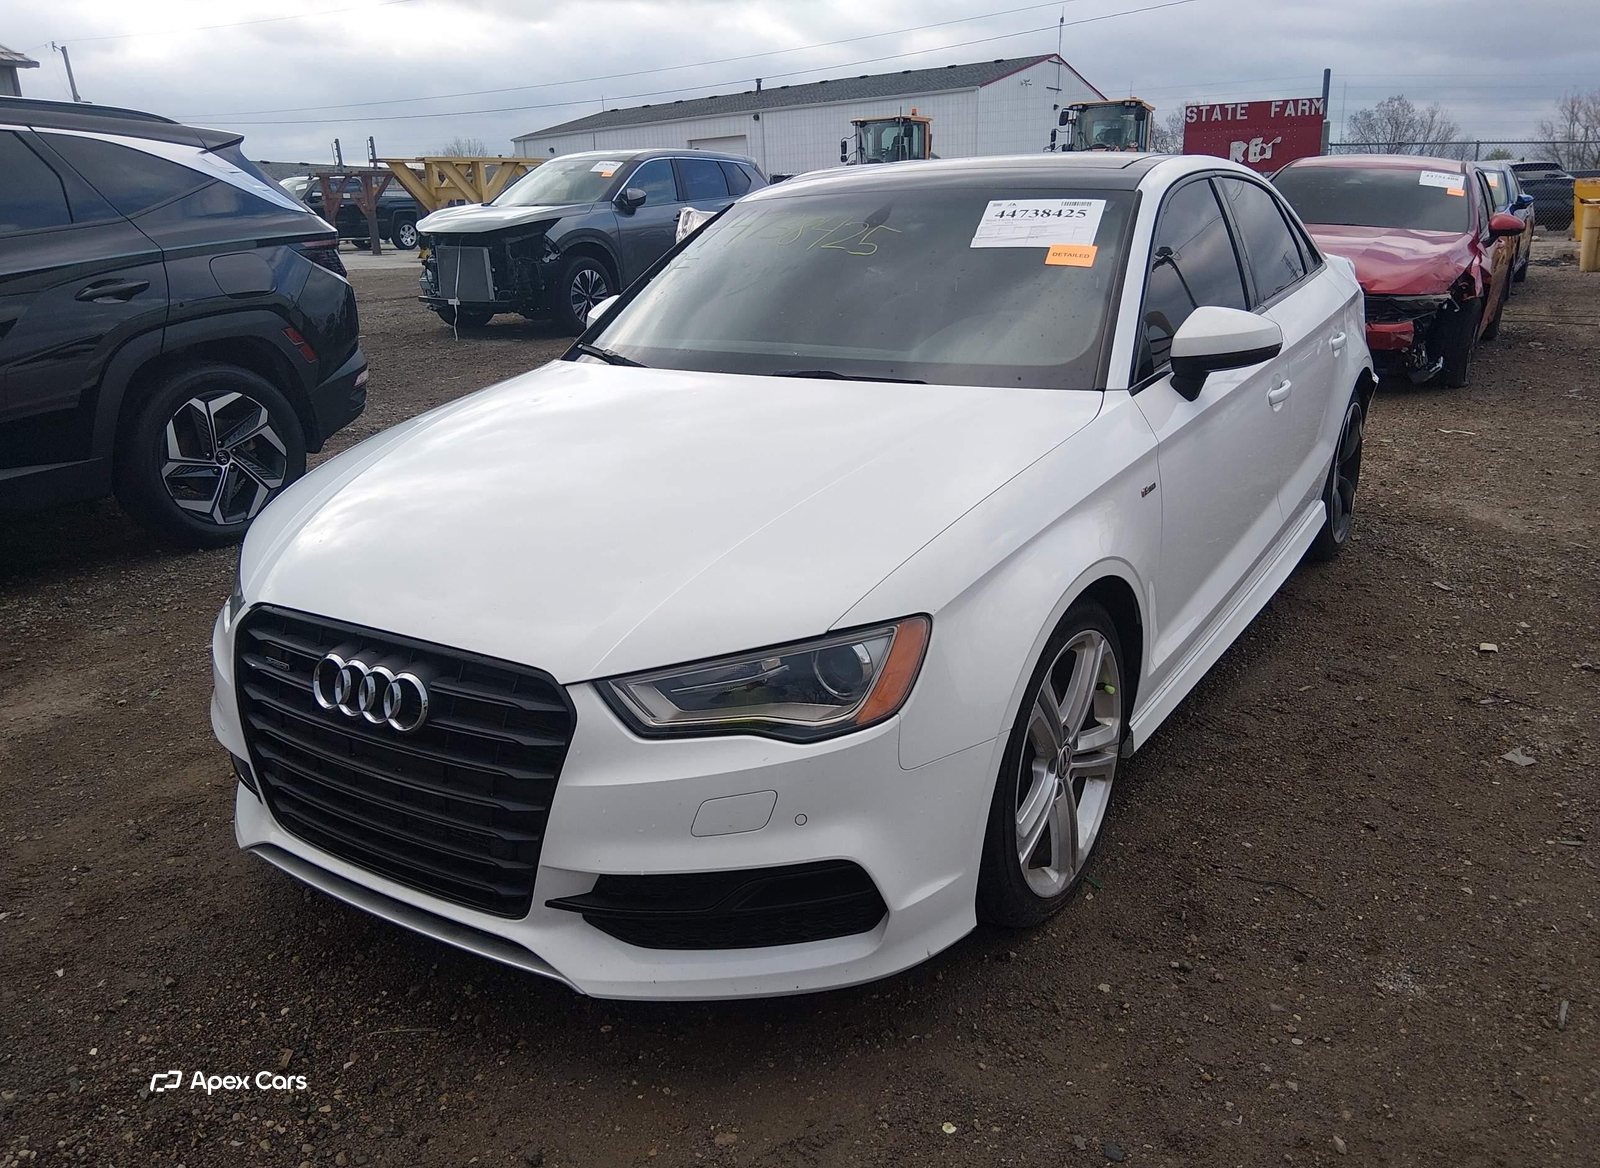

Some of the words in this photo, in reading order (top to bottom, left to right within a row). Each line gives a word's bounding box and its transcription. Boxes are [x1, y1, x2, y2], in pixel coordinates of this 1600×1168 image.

[1186, 103, 1249, 123] STATE
[1271, 98, 1325, 118] FARM
[994, 208, 1088, 219] 44738425
[1052, 251, 1091, 259] DETAILED
